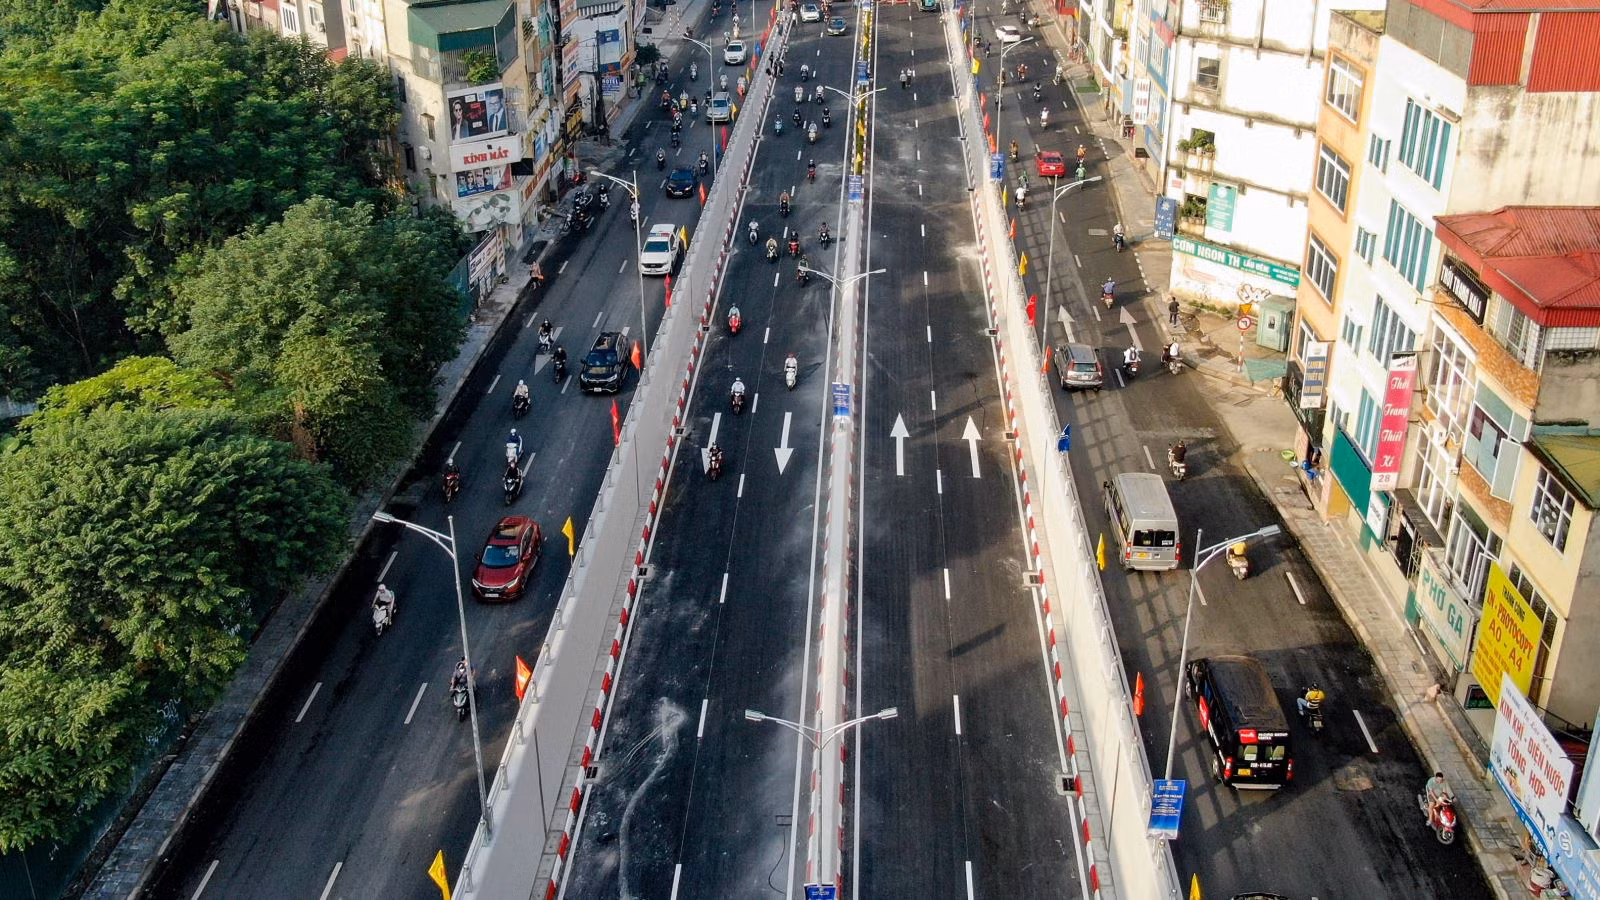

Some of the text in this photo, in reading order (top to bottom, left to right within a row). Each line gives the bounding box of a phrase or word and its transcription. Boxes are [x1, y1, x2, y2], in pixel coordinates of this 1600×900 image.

[464, 146, 509, 165] KÍNH MẮT
[1197, 245, 1225, 263] NGON
[1378, 474, 1391, 483] 28
[1447, 603, 1463, 639] GÀ
[1497, 603, 1533, 660] PHOTOCOPY
[1508, 646, 1523, 673] A4
[1499, 695, 1513, 725] KIM
[1512, 713, 1525, 742] KHÍ
